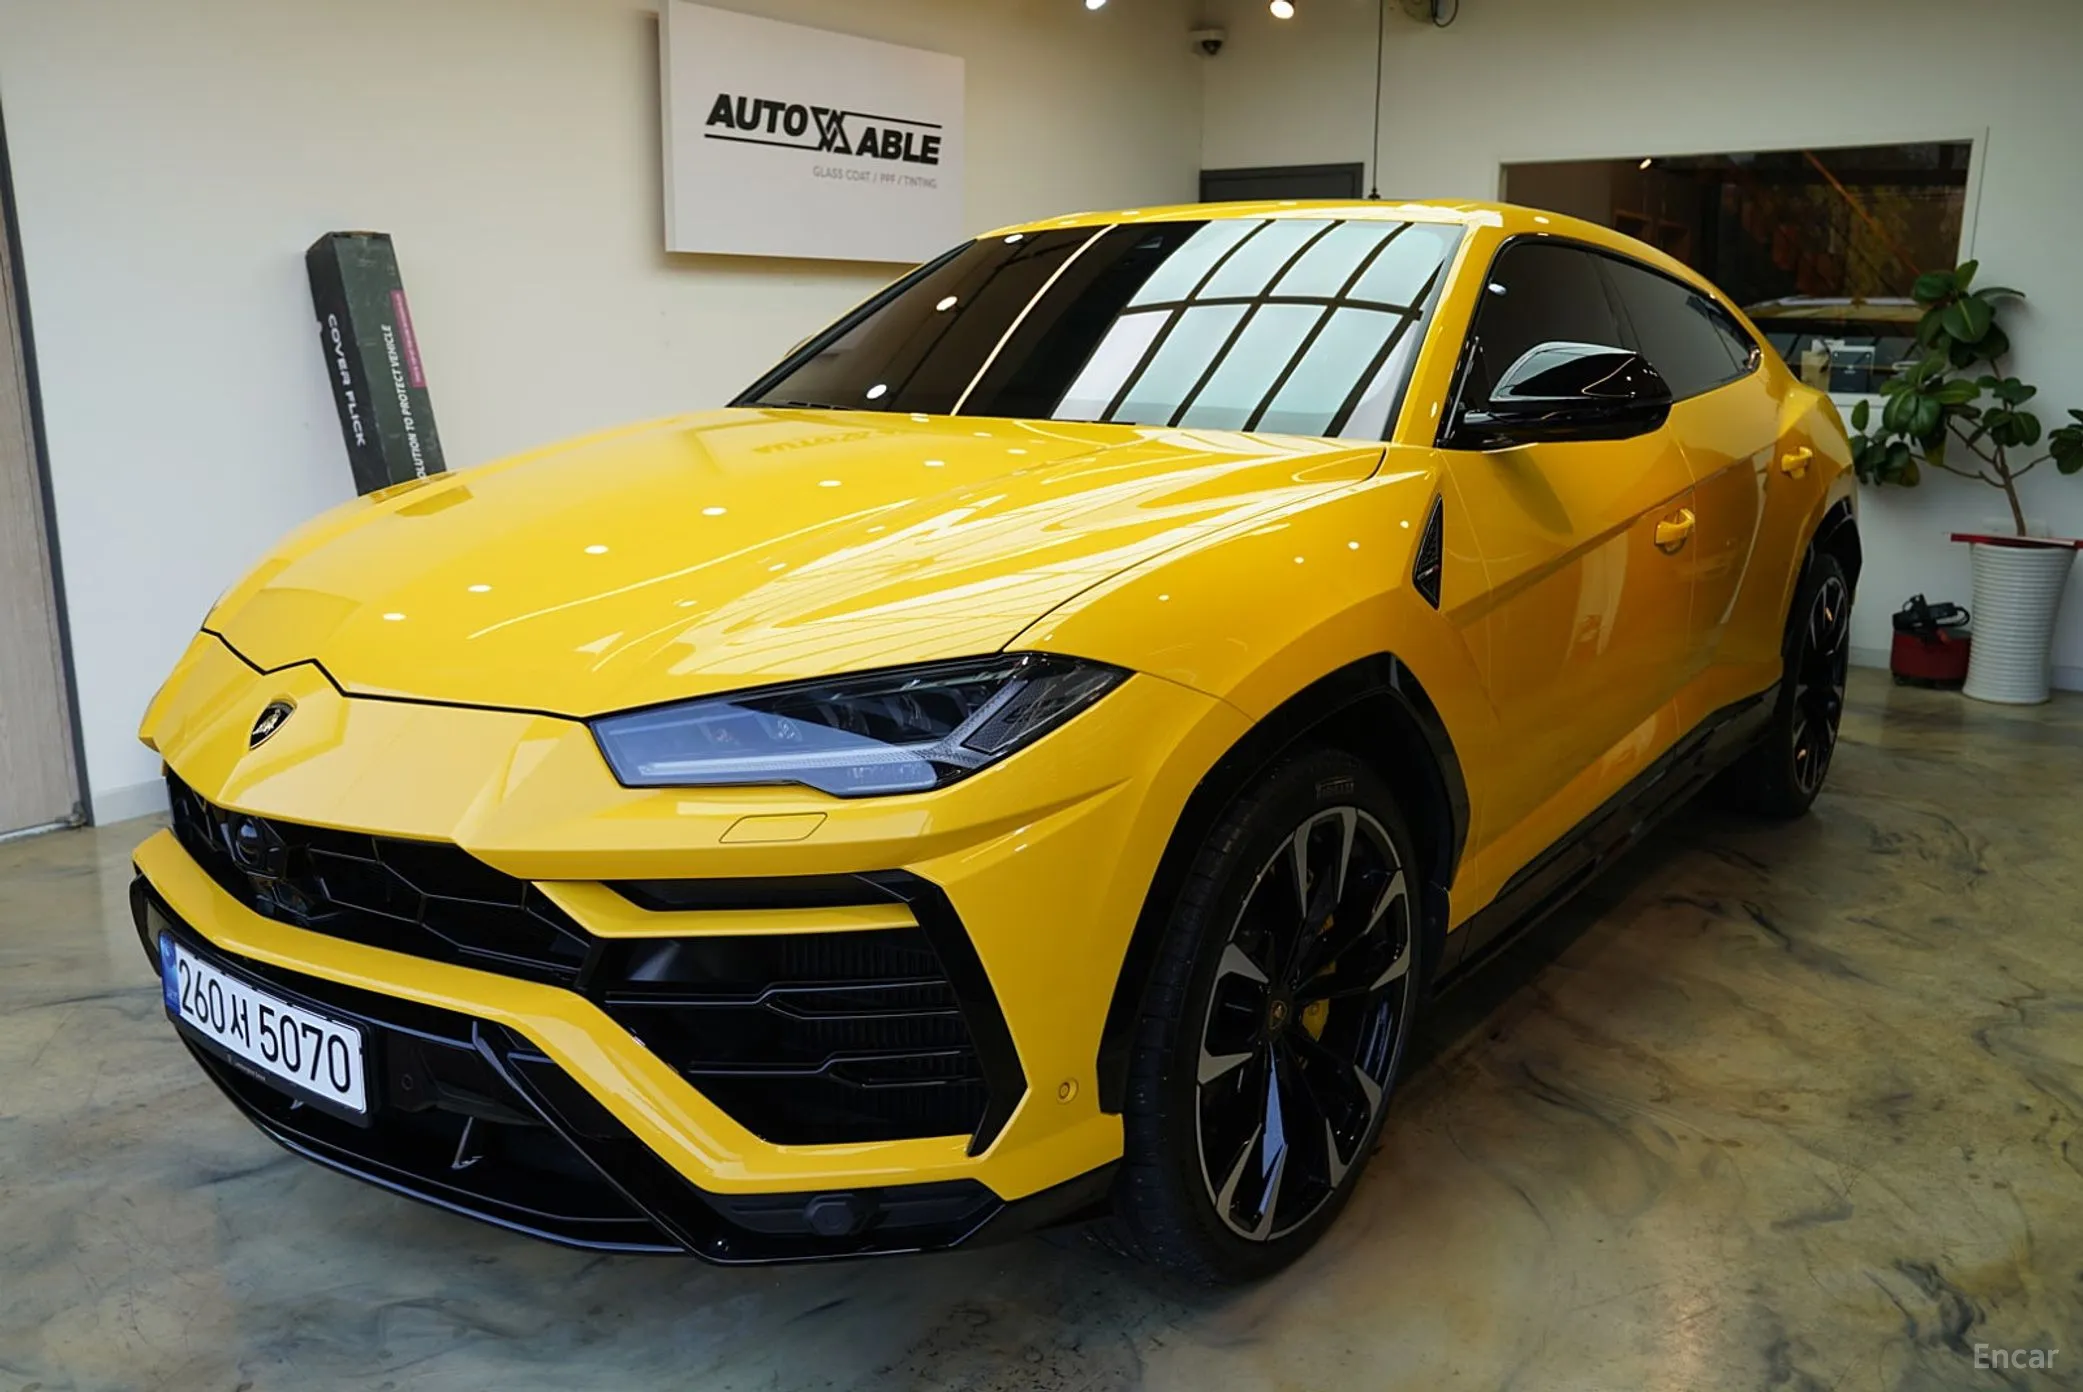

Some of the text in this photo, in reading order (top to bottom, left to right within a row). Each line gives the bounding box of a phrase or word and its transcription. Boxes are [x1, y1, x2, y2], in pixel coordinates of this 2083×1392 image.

[705, 93, 942, 166] AUTO ABLE
[812, 165, 843, 180] GLASS
[845, 169, 871, 182] COAT
[904, 175, 938, 189] TINTING
[381, 324, 400, 370] VEHICLE
[328, 313, 366, 447] COVER FLICK
[391, 367, 412, 418] PROTECT
[403, 415, 417, 433] TO
[259, 1004, 351, 1093] 5070
